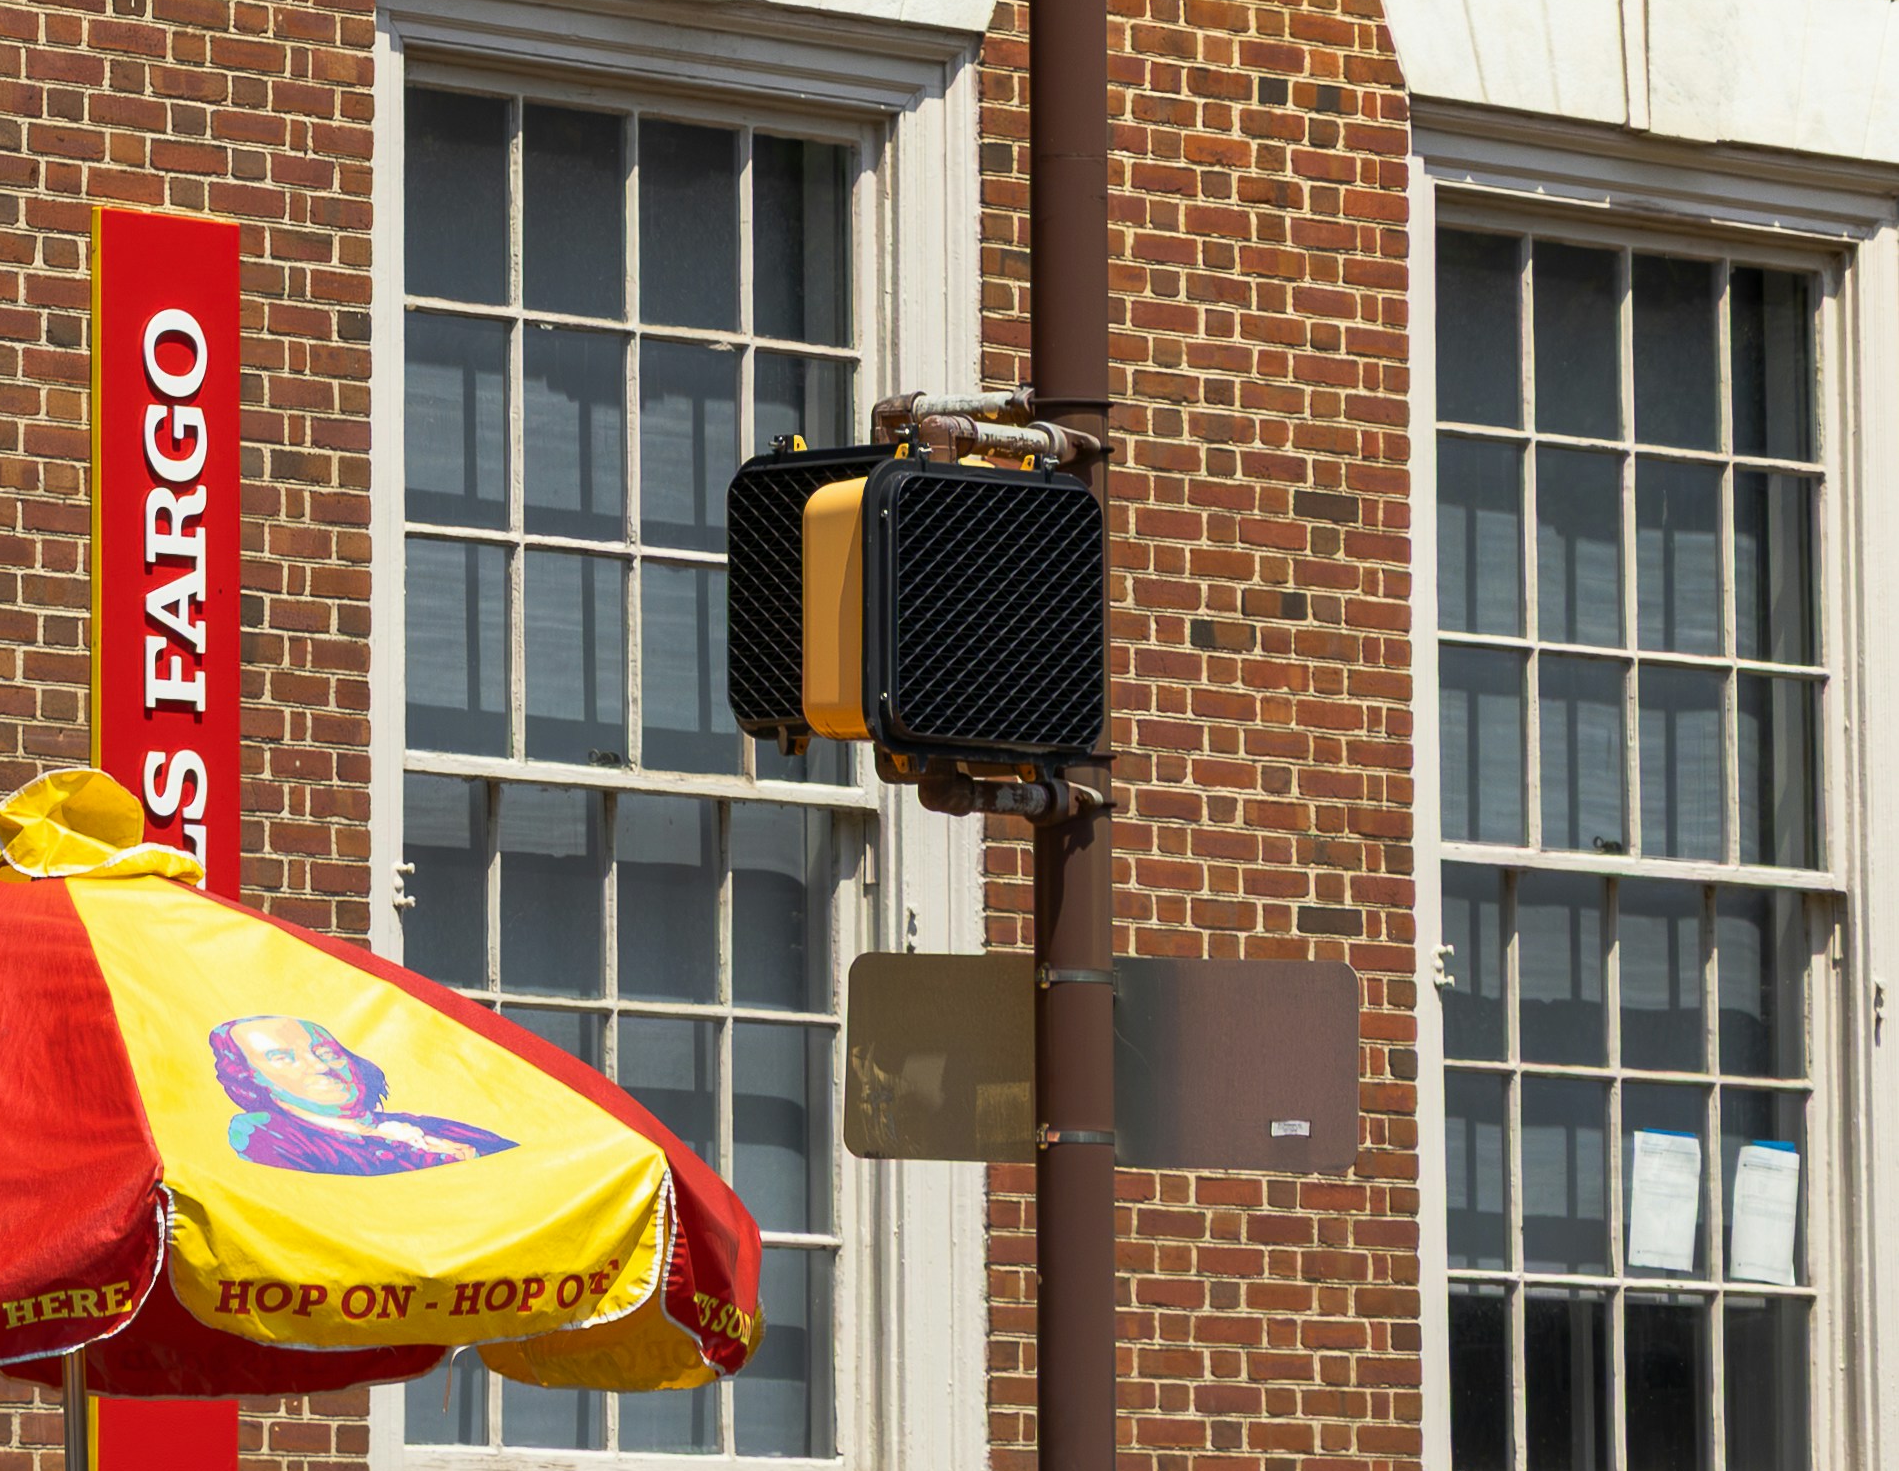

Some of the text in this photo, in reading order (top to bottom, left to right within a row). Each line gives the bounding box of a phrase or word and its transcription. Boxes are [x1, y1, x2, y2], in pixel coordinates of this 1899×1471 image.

[143, 306, 209, 713] FARGO
[1, 1280, 134, 1330] HERE
[214, 1279, 328, 1317] HOP
[341, 1284, 418, 1320] ON
[449, 1277, 546, 1317] HOP
